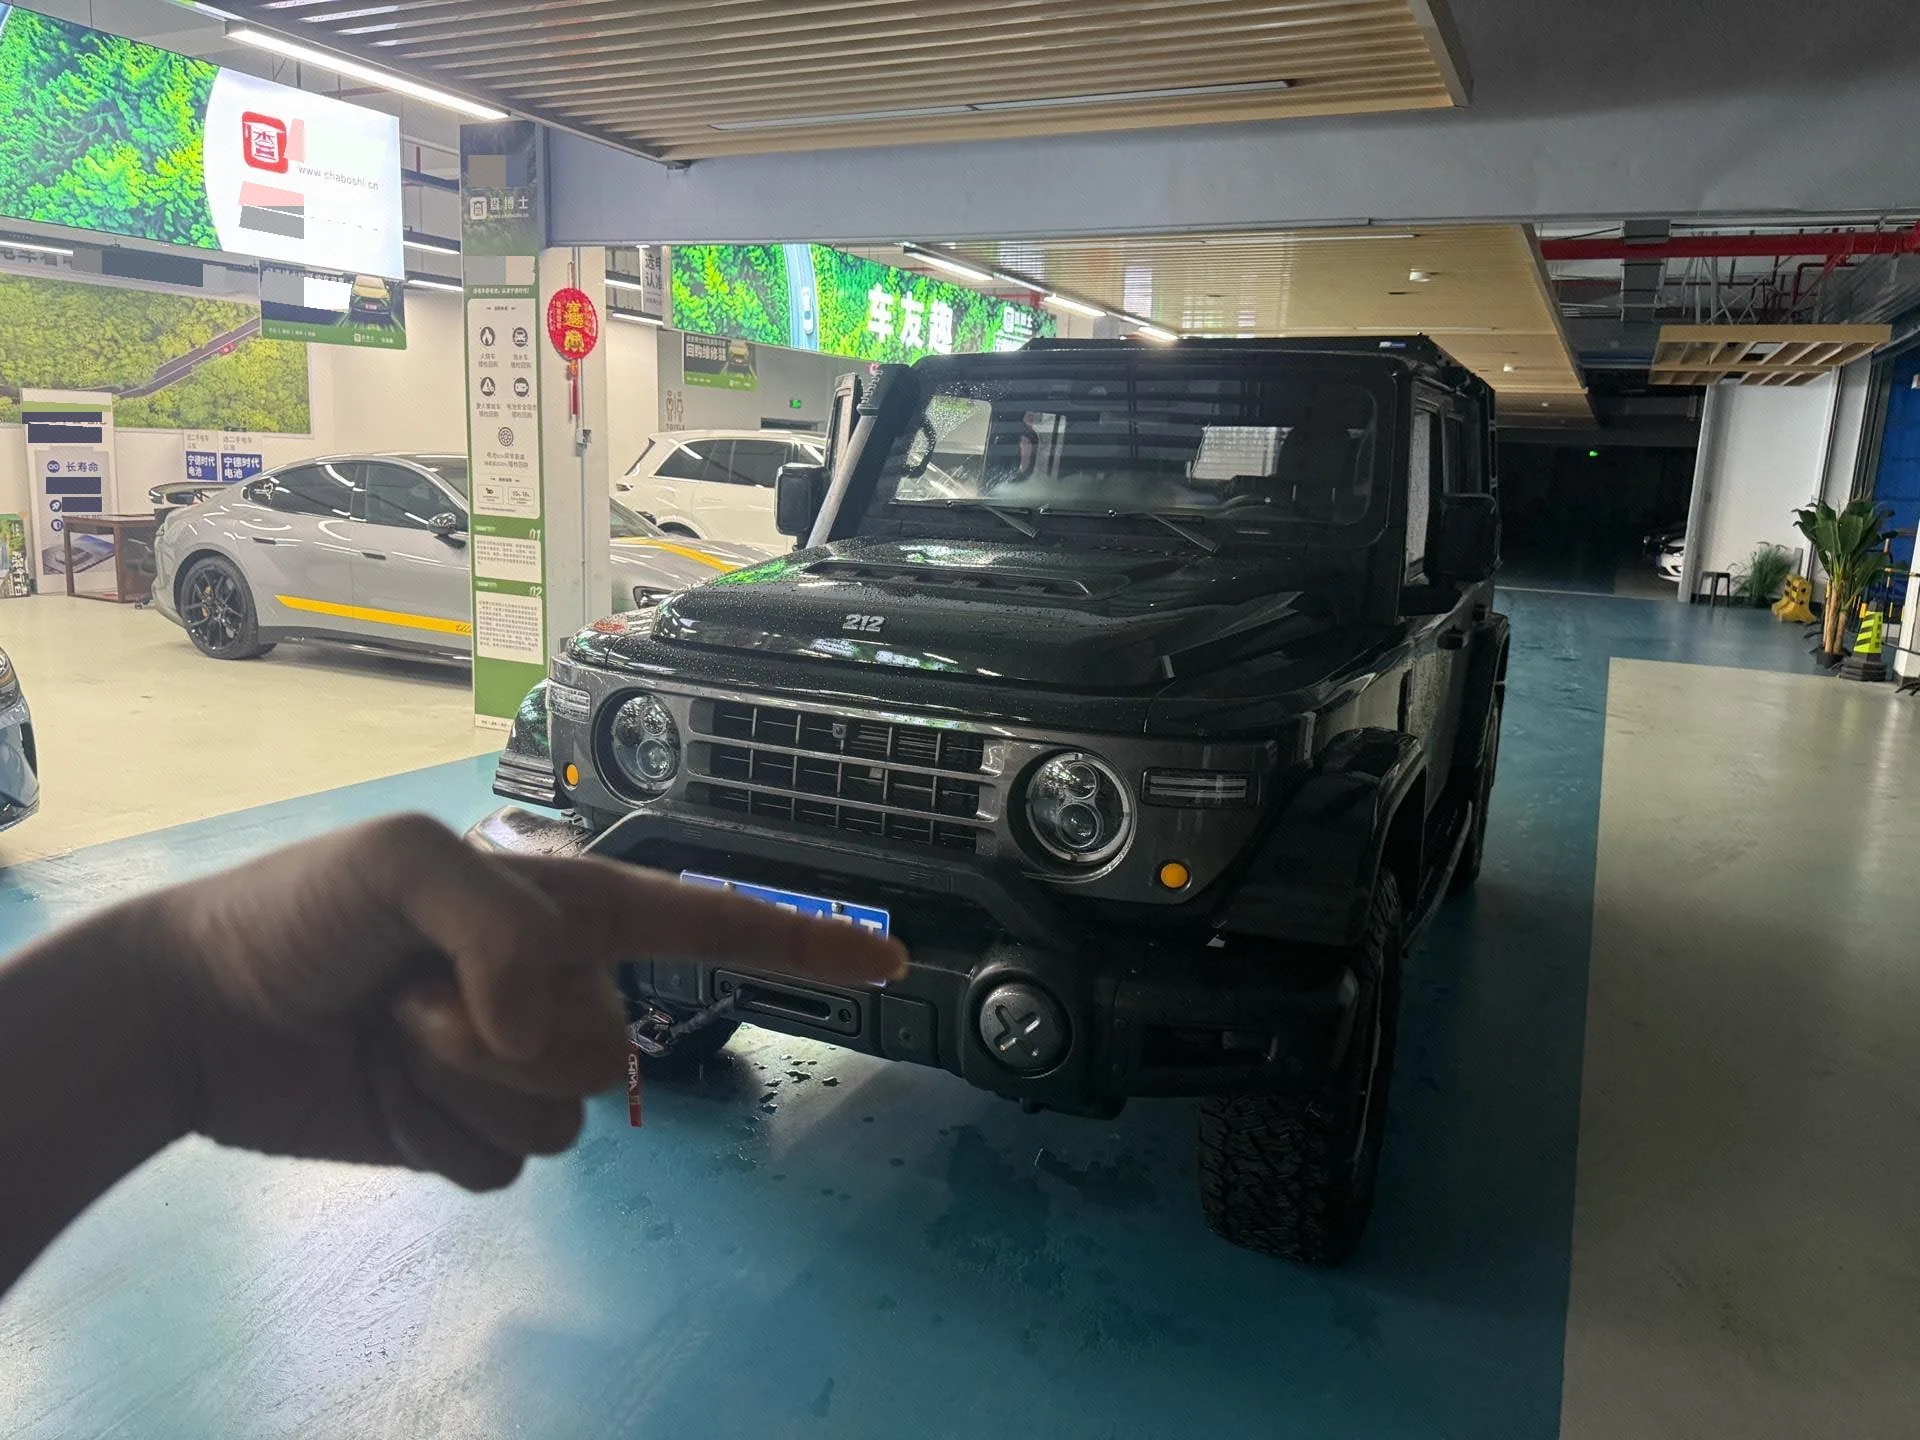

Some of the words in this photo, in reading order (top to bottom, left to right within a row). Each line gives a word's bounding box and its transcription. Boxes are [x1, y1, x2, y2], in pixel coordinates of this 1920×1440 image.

[867, 282, 953, 354] 车友趣
[66, 461, 99, 473] 长寿命
[187, 454, 216, 467] 宁德时代
[223, 456, 260, 469] 宁德时代
[188, 466, 203, 477] 电池
[224, 468, 243, 479] 电池
[529, 527, 541, 541] 01
[529, 586, 543, 599] 02
[842, 613, 885, 633] 212
